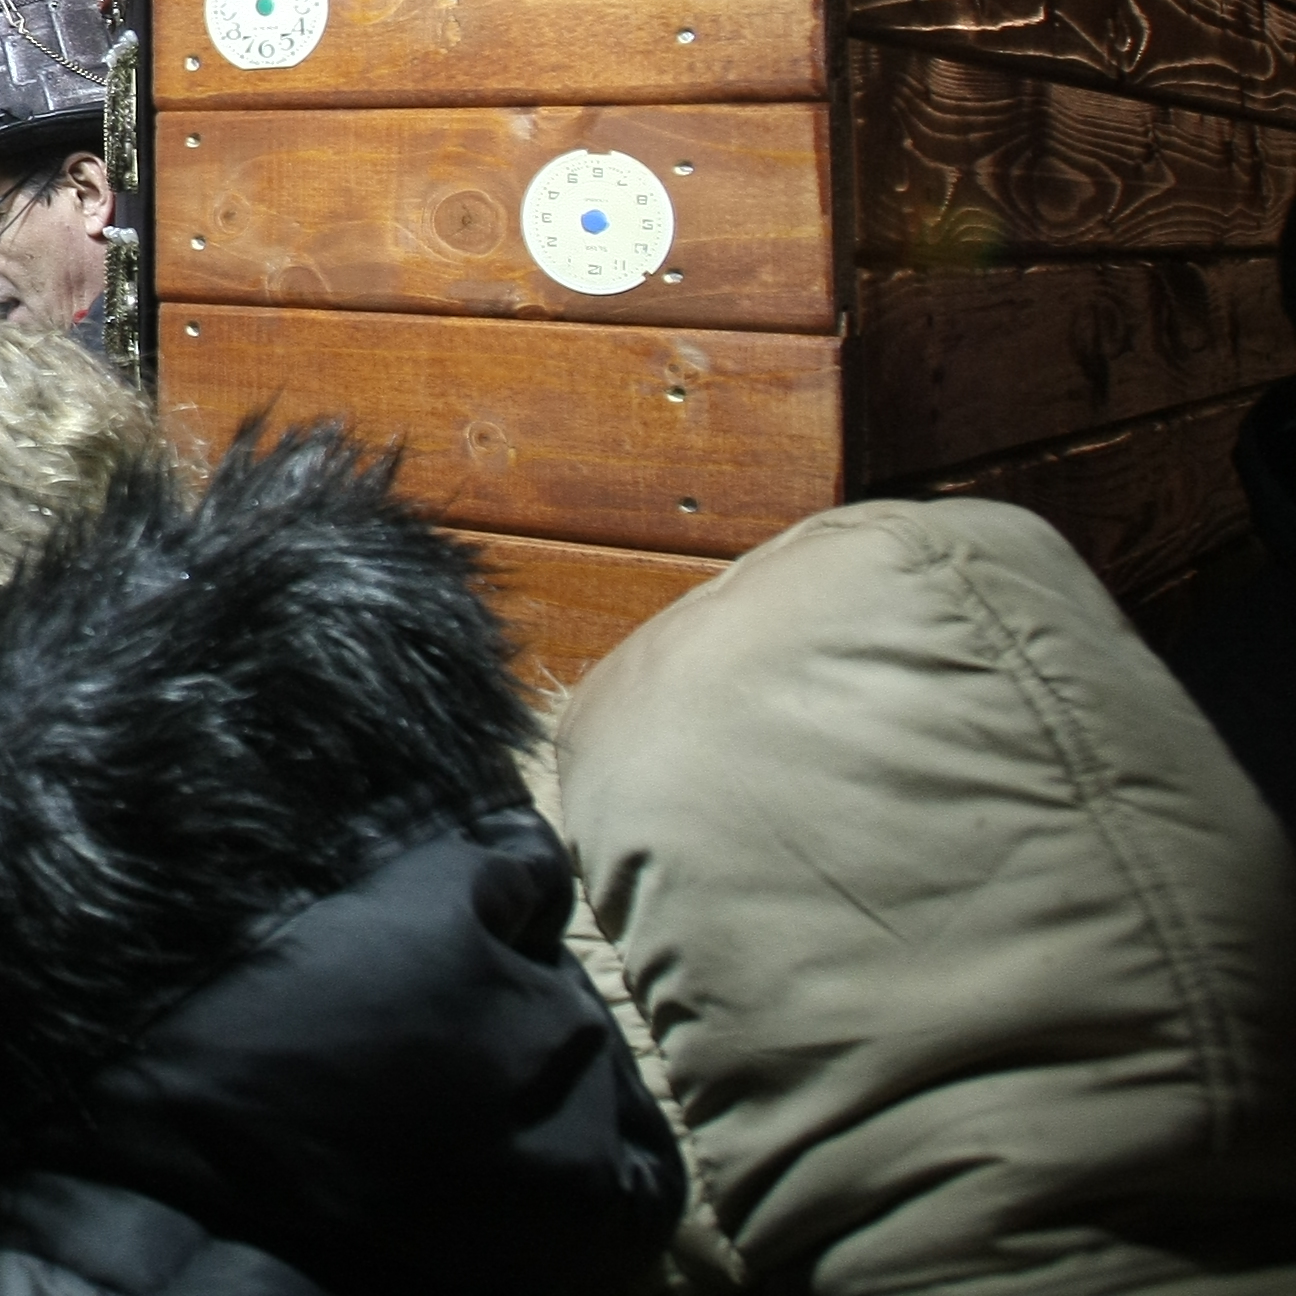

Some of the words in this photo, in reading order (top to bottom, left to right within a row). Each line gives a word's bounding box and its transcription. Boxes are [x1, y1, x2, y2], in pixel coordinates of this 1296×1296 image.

[226, 22, 241, 41] 8
[291, 17, 305, 35] 4
[242, 35, 255, 53] 7
[258, 39, 275, 58] 6
[280, 33, 294, 51] 5
